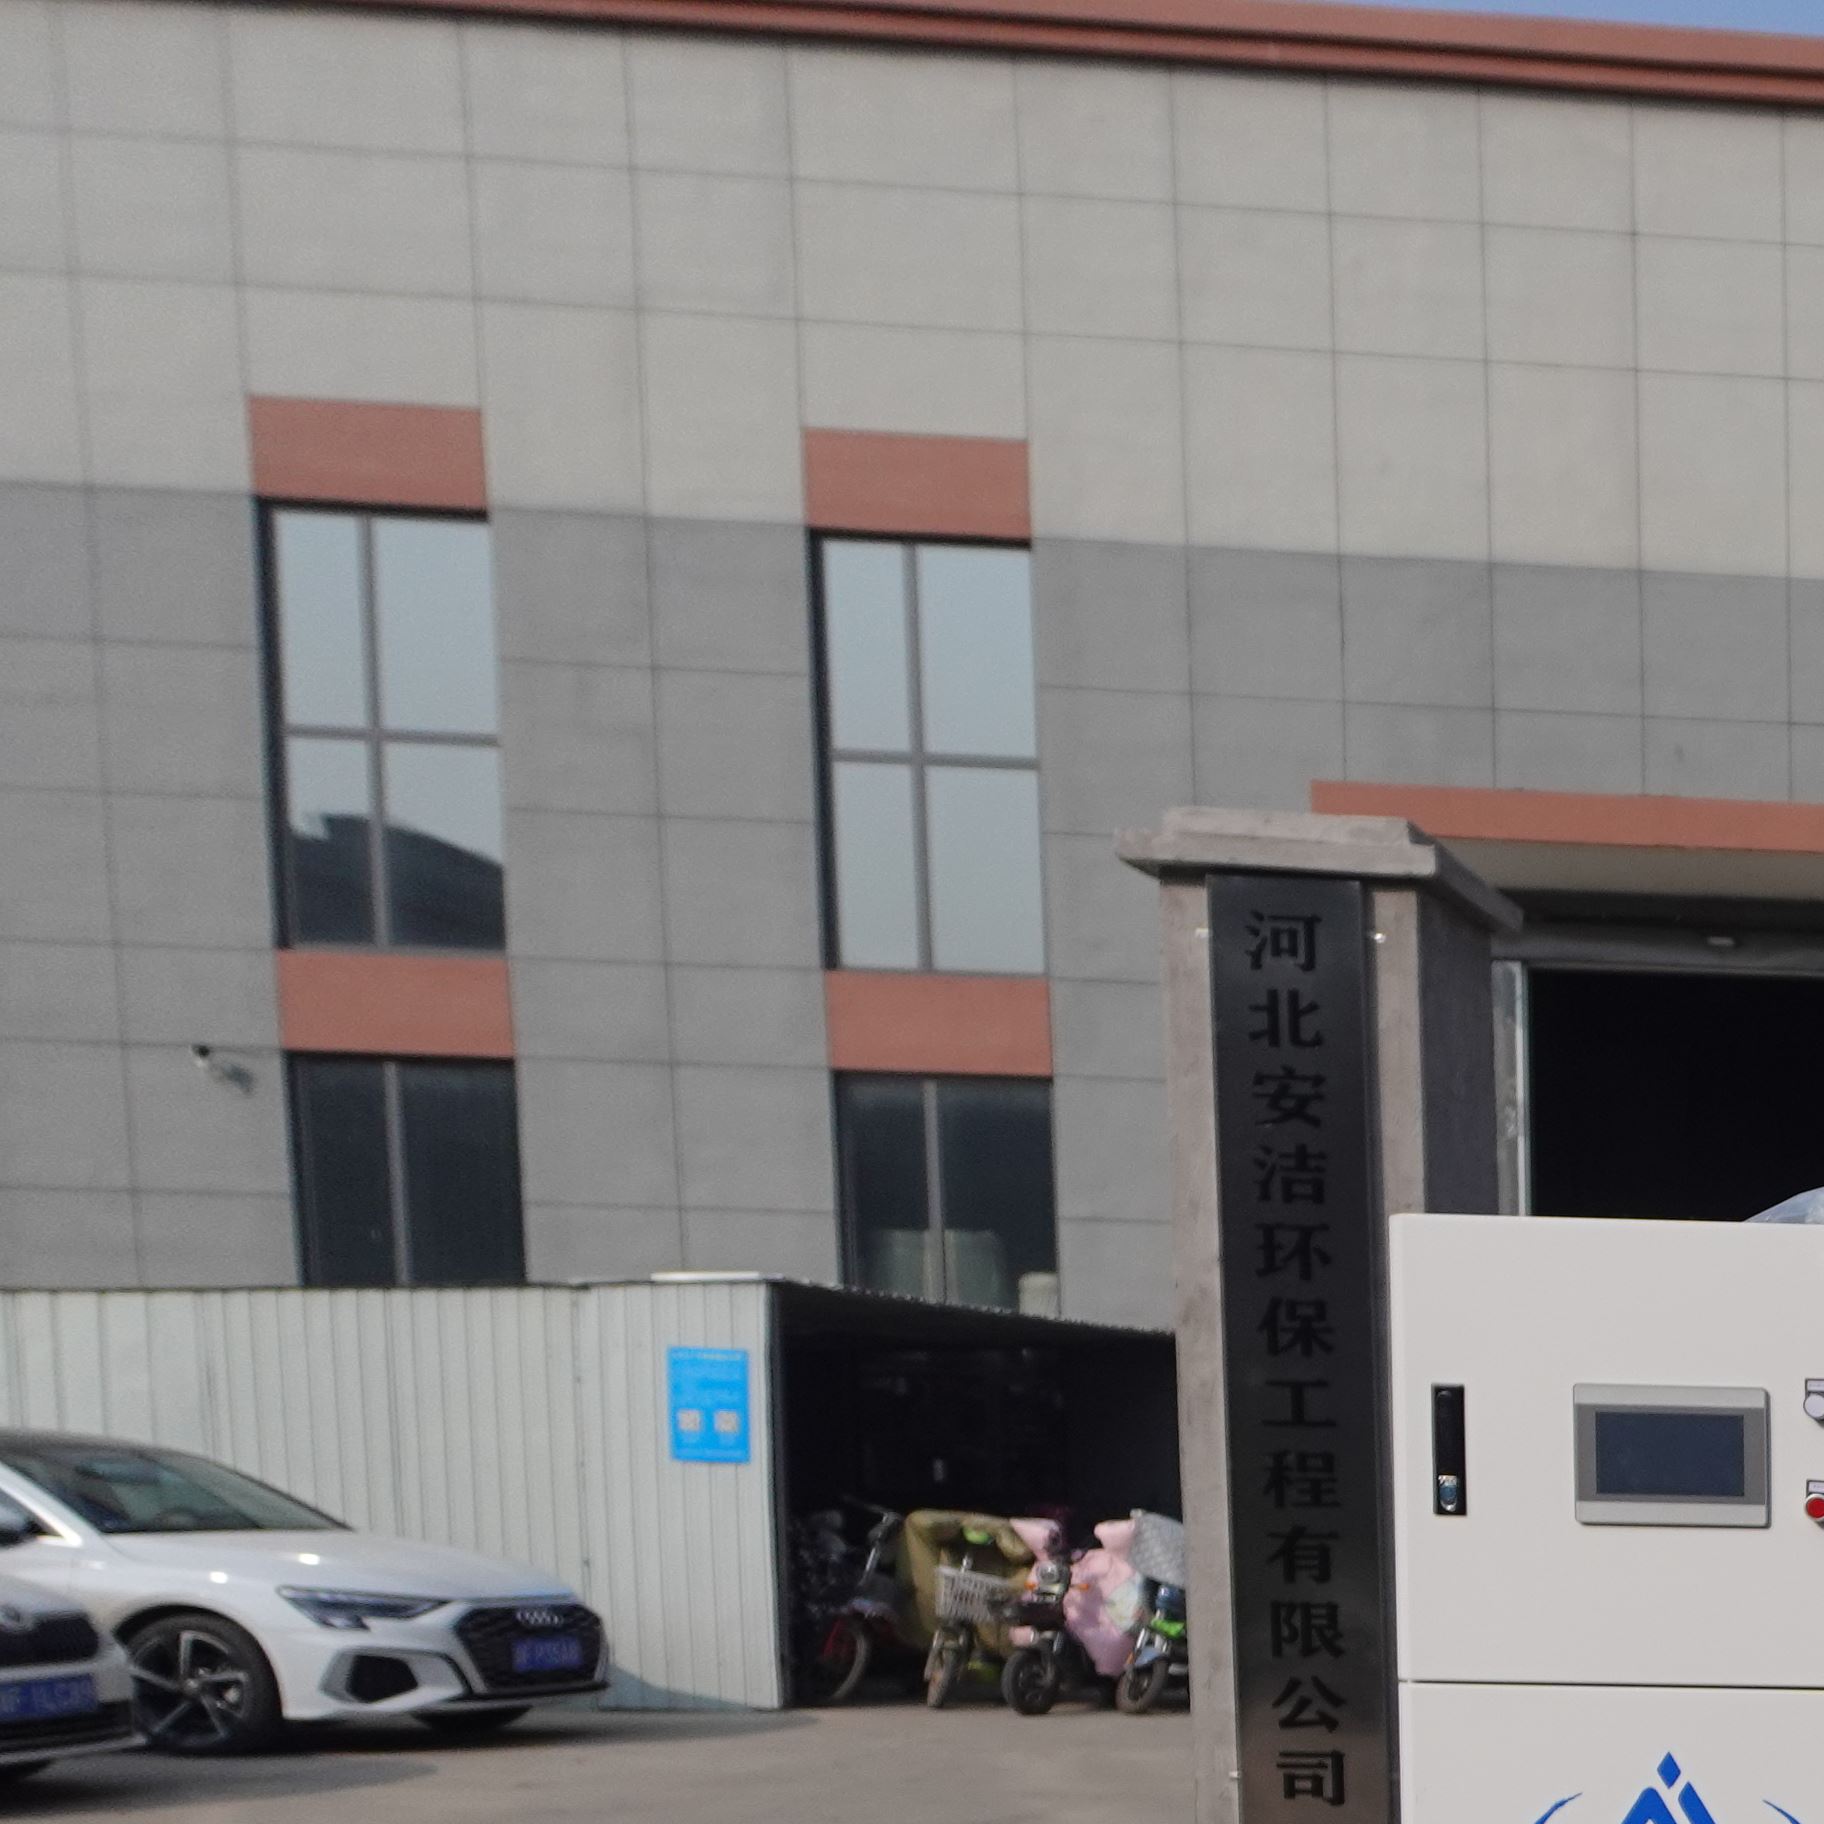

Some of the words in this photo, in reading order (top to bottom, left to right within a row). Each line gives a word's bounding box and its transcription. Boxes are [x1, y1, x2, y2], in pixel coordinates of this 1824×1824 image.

[1243, 910, 1347, 1808] 河北安洁环保工程有限公司
